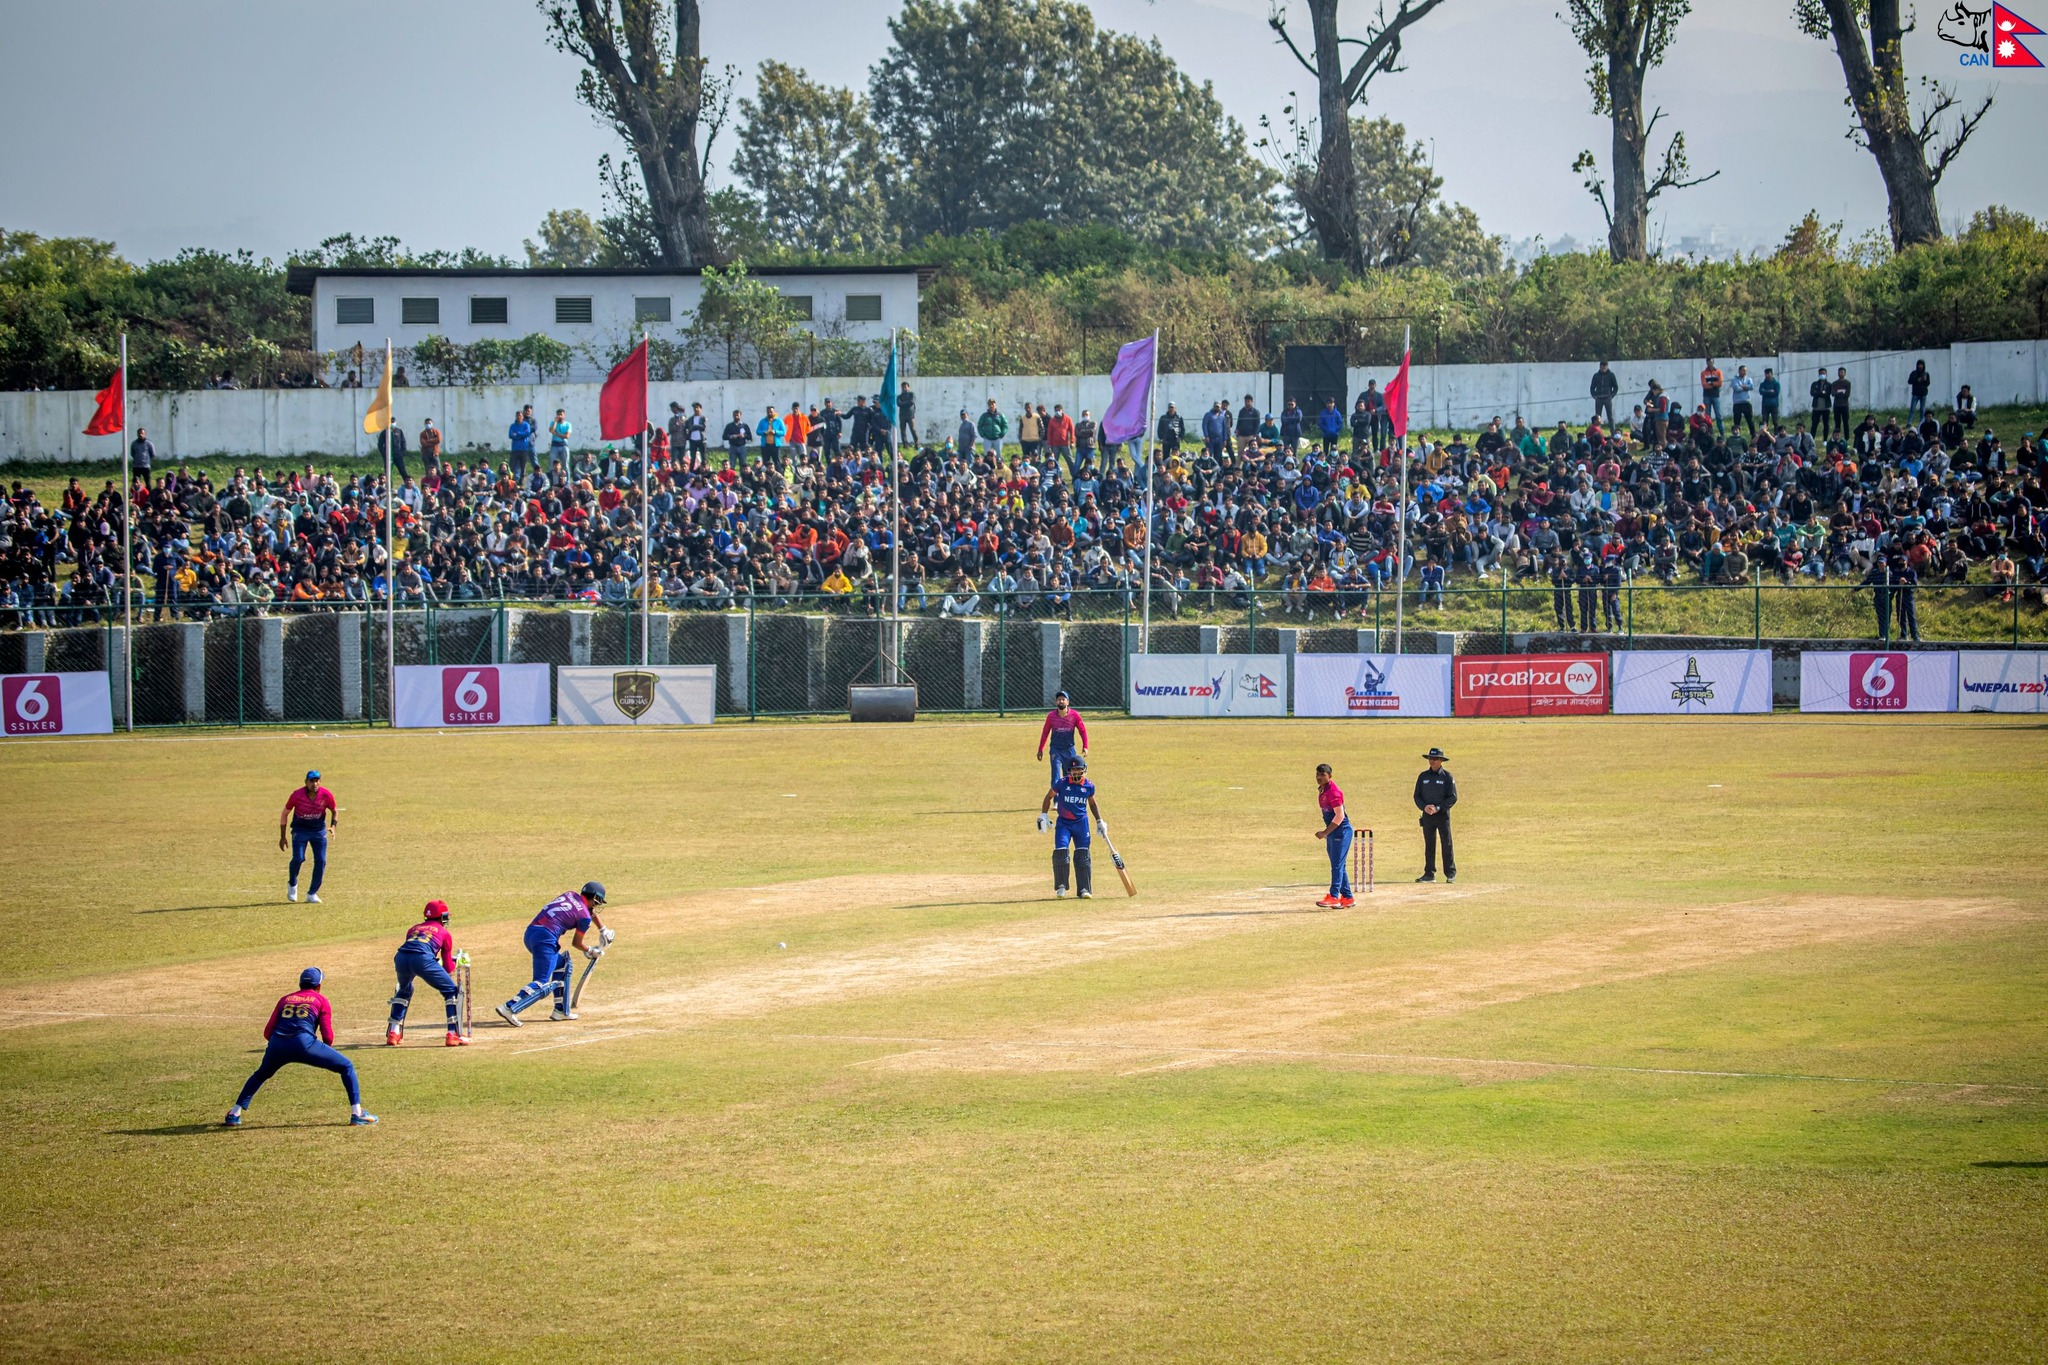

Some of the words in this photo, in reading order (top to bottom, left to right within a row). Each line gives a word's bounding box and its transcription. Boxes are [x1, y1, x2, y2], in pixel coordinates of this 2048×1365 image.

[1567, 673, 1593, 683] PAY
[1862, 657, 1895, 697] 6
[454, 671, 487, 712] 6
[1146, 686, 1188, 696] NEPAL
[1188, 686, 1213, 696] T20
[1973, 683, 2018, 693] NEPAL
[2018, 683, 2044, 693] T20
[15, 680, 49, 722] 6
[1855, 698, 1900, 706] SSIXER
[448, 712, 494, 721] SSIXER
[11, 721, 56, 731] SSIXER
